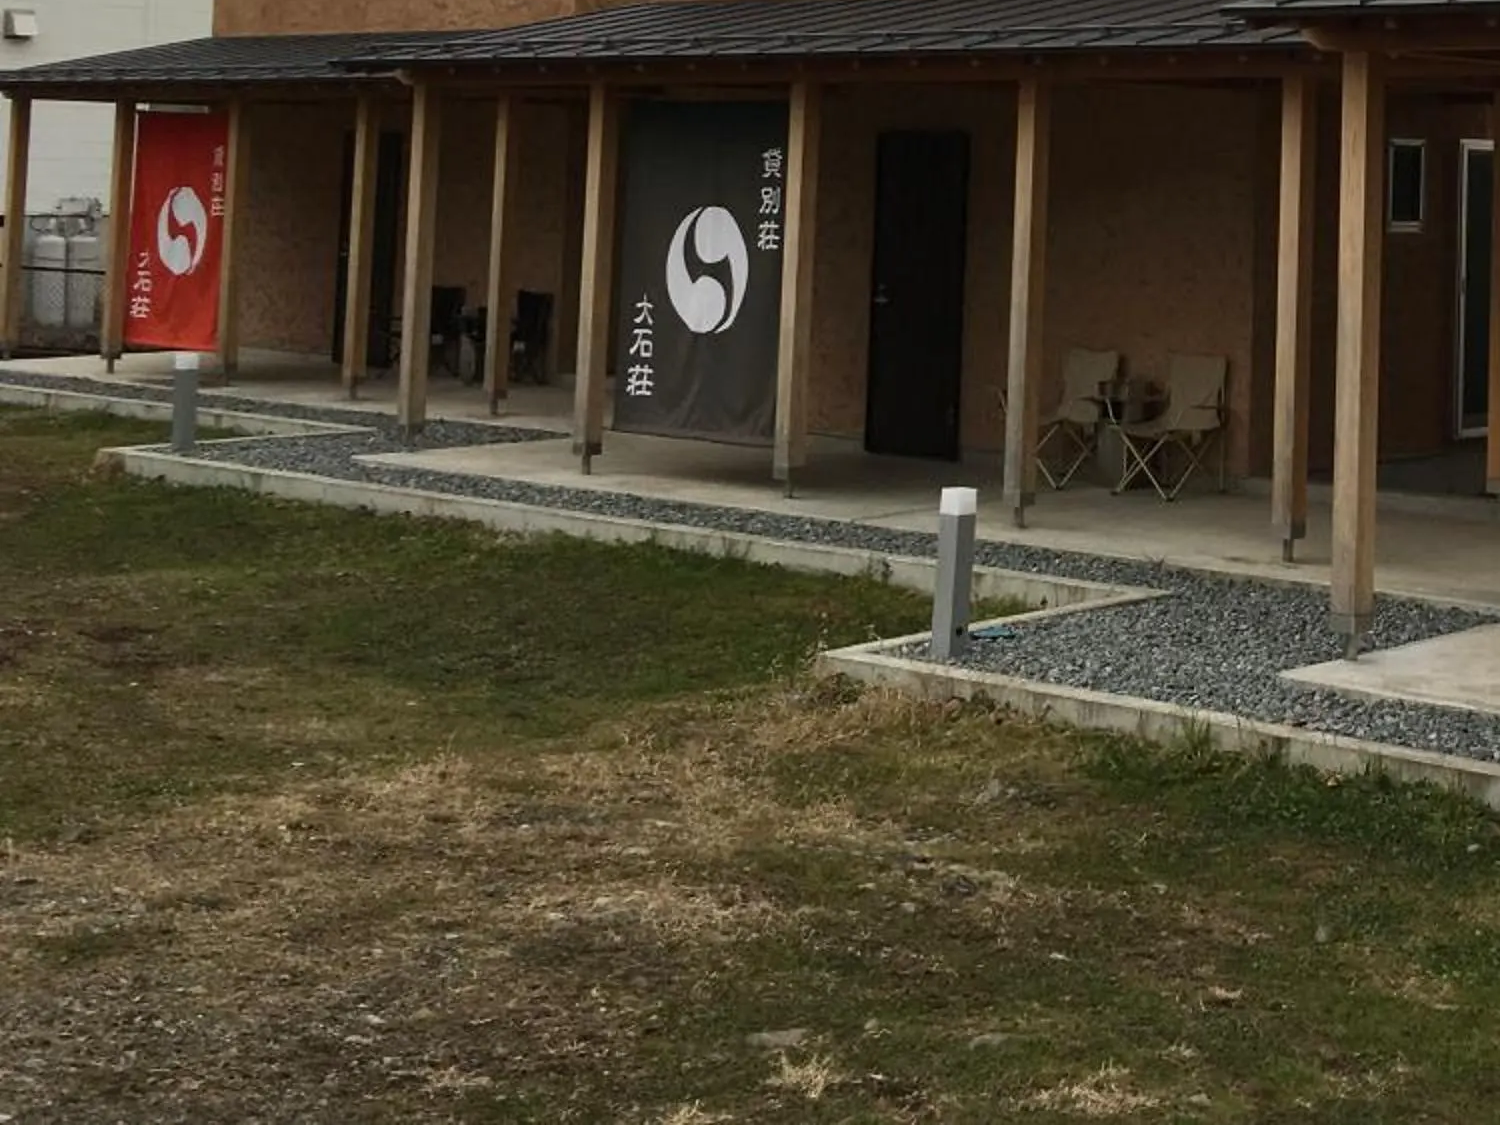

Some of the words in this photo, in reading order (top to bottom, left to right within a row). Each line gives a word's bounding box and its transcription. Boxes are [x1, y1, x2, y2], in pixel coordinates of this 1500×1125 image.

[757, 147, 783, 250] 貸別荘
[625, 293, 655, 396] 大石荘
